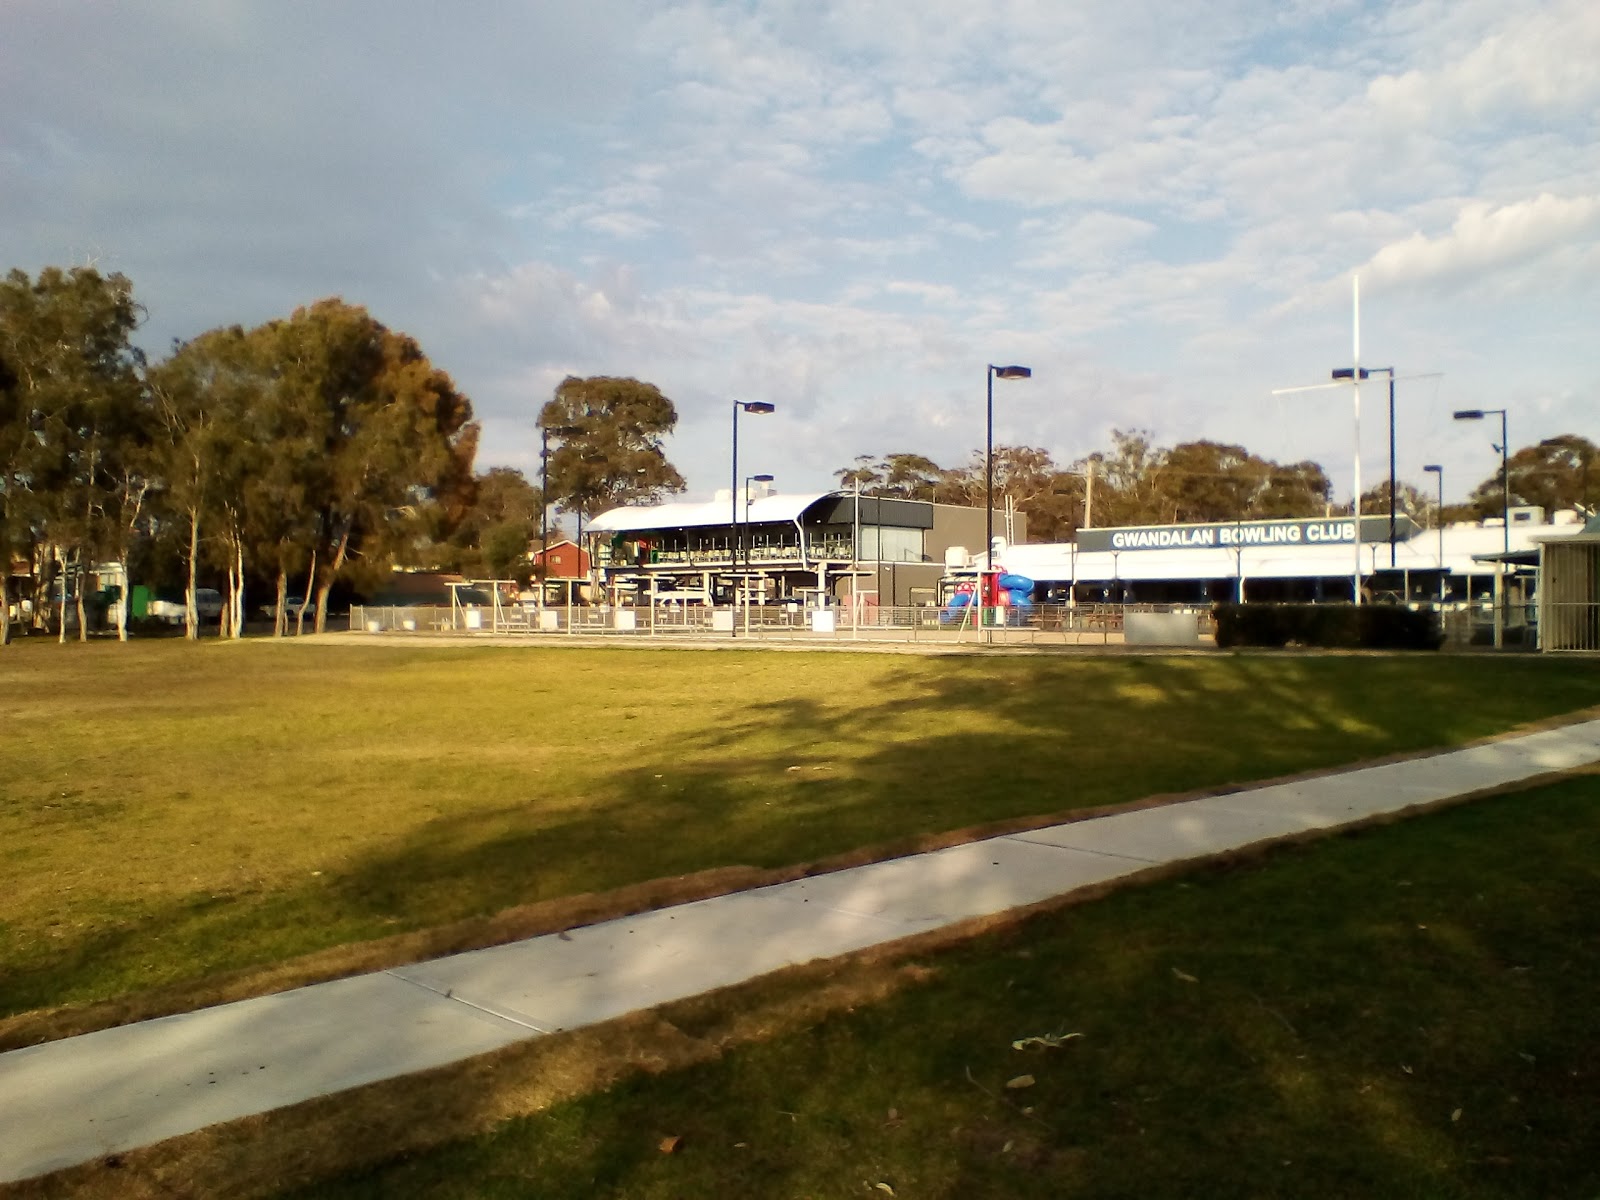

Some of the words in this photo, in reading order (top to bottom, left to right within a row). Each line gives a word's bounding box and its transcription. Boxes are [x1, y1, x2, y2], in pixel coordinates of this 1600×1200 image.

[1112, 529, 1213, 548] GWANDALAN
[1219, 525, 1301, 544] BOWLING
[1306, 522, 1355, 541] CLUB
